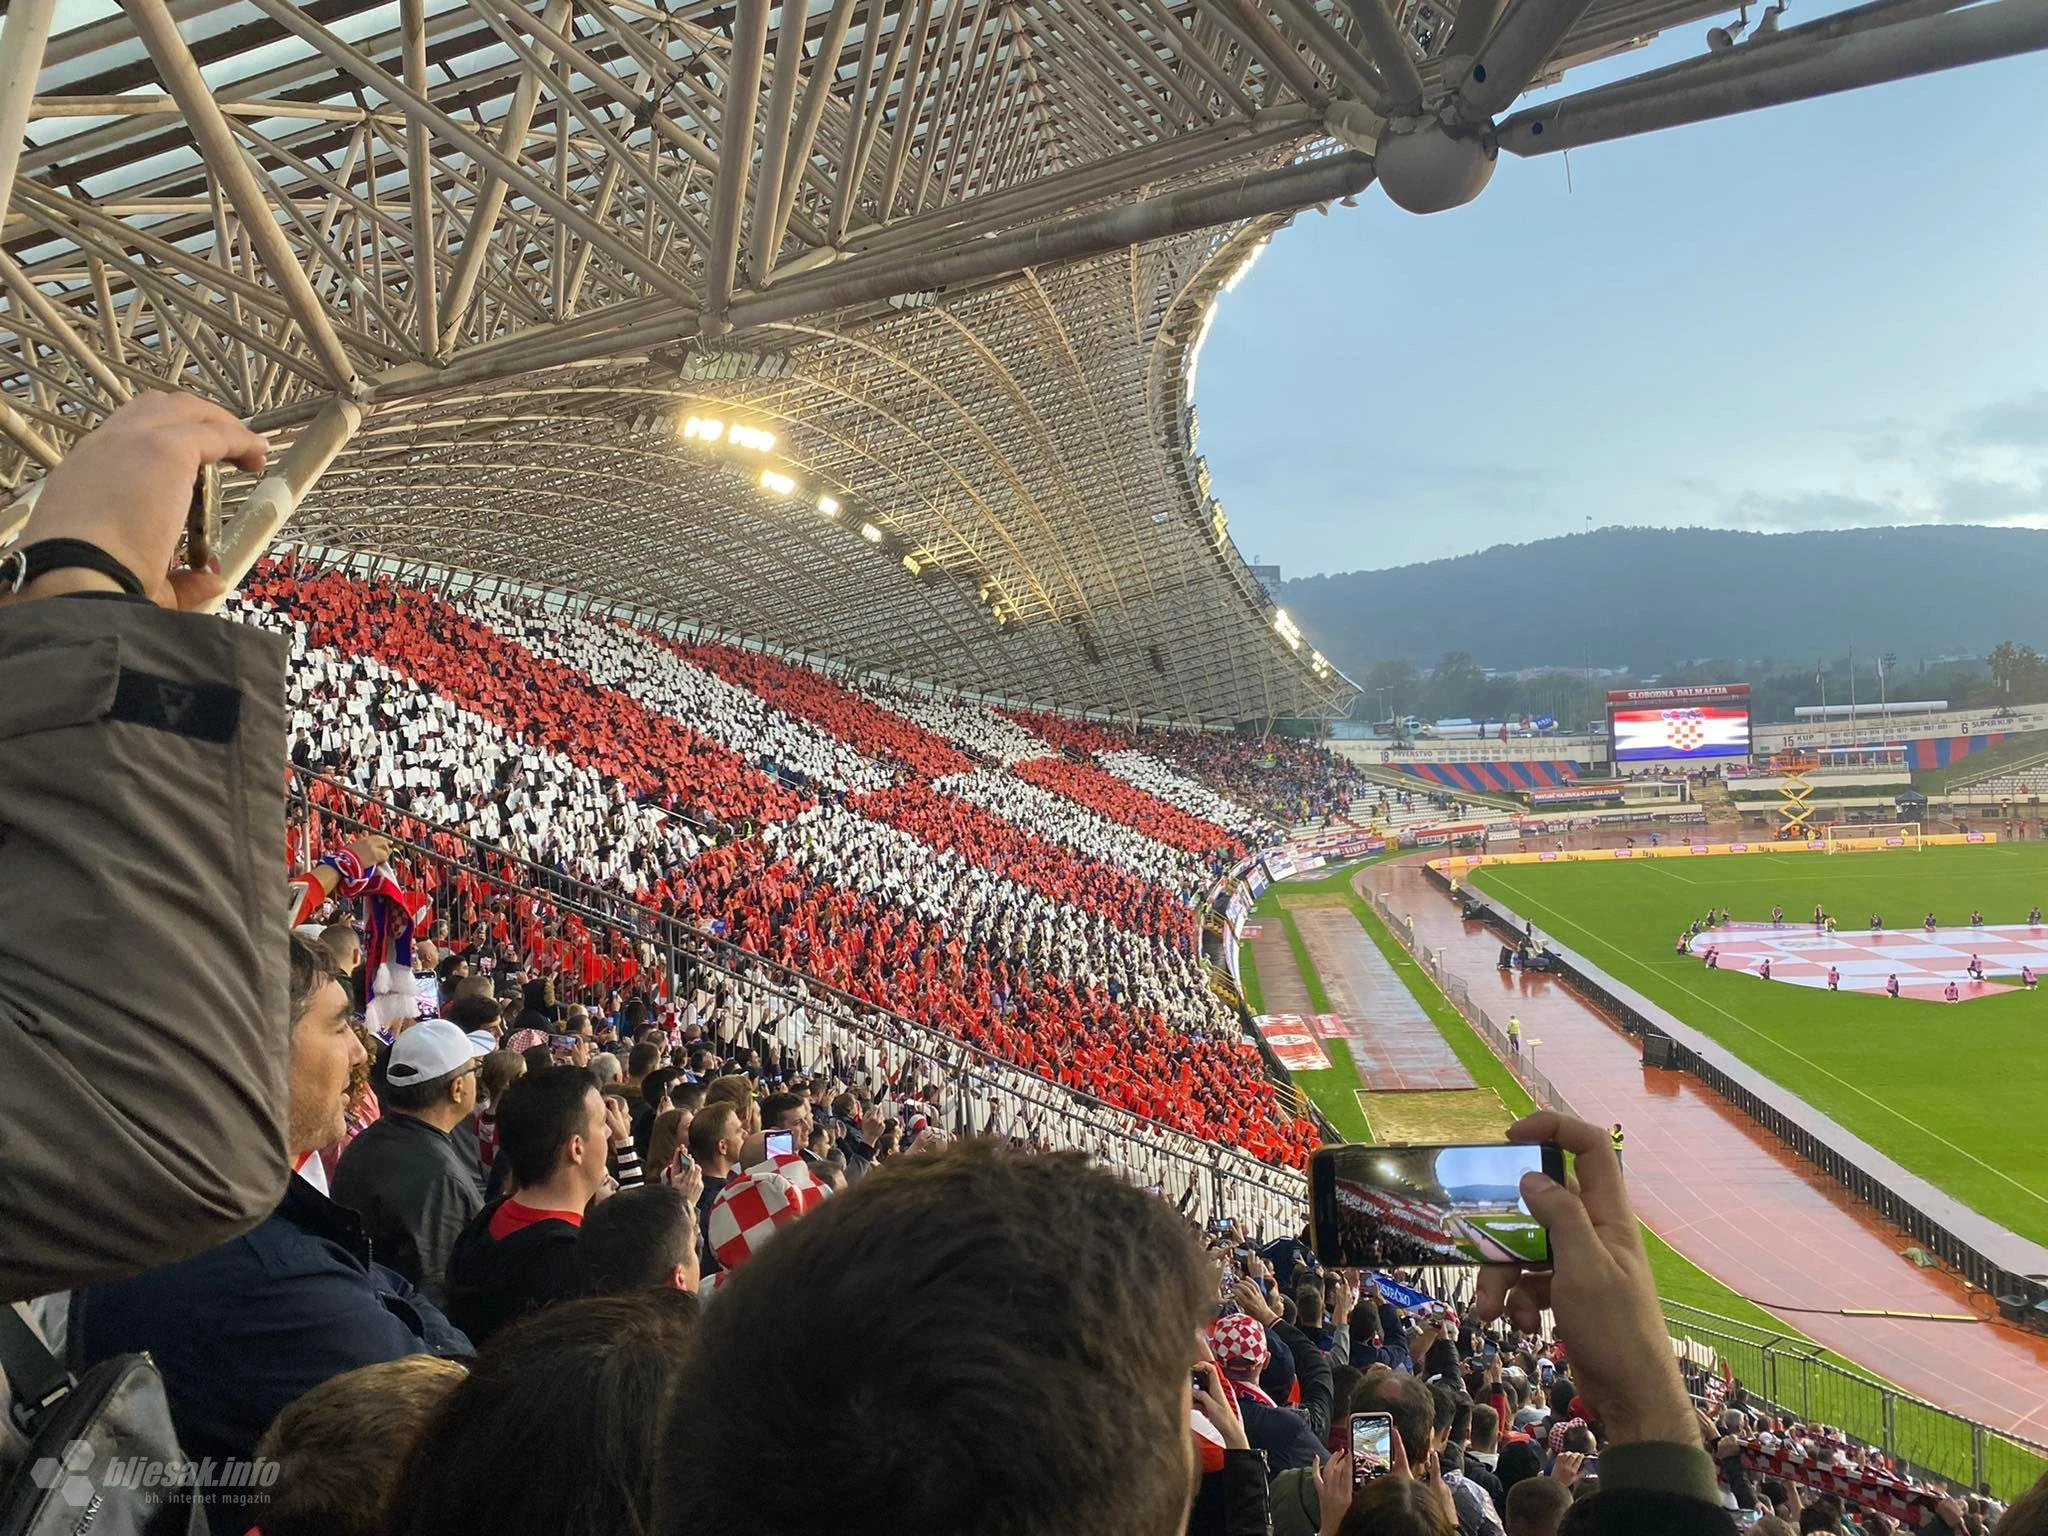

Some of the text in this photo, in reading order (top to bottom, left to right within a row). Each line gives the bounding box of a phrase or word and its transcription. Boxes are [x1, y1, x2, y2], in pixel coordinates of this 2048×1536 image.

[1628, 686, 1728, 699] SLOBODNA DALMACIJA
[1961, 722, 1969, 735] 6
[1783, 734, 1814, 747] 15 KUP
[1380, 751, 1390, 762] 18
